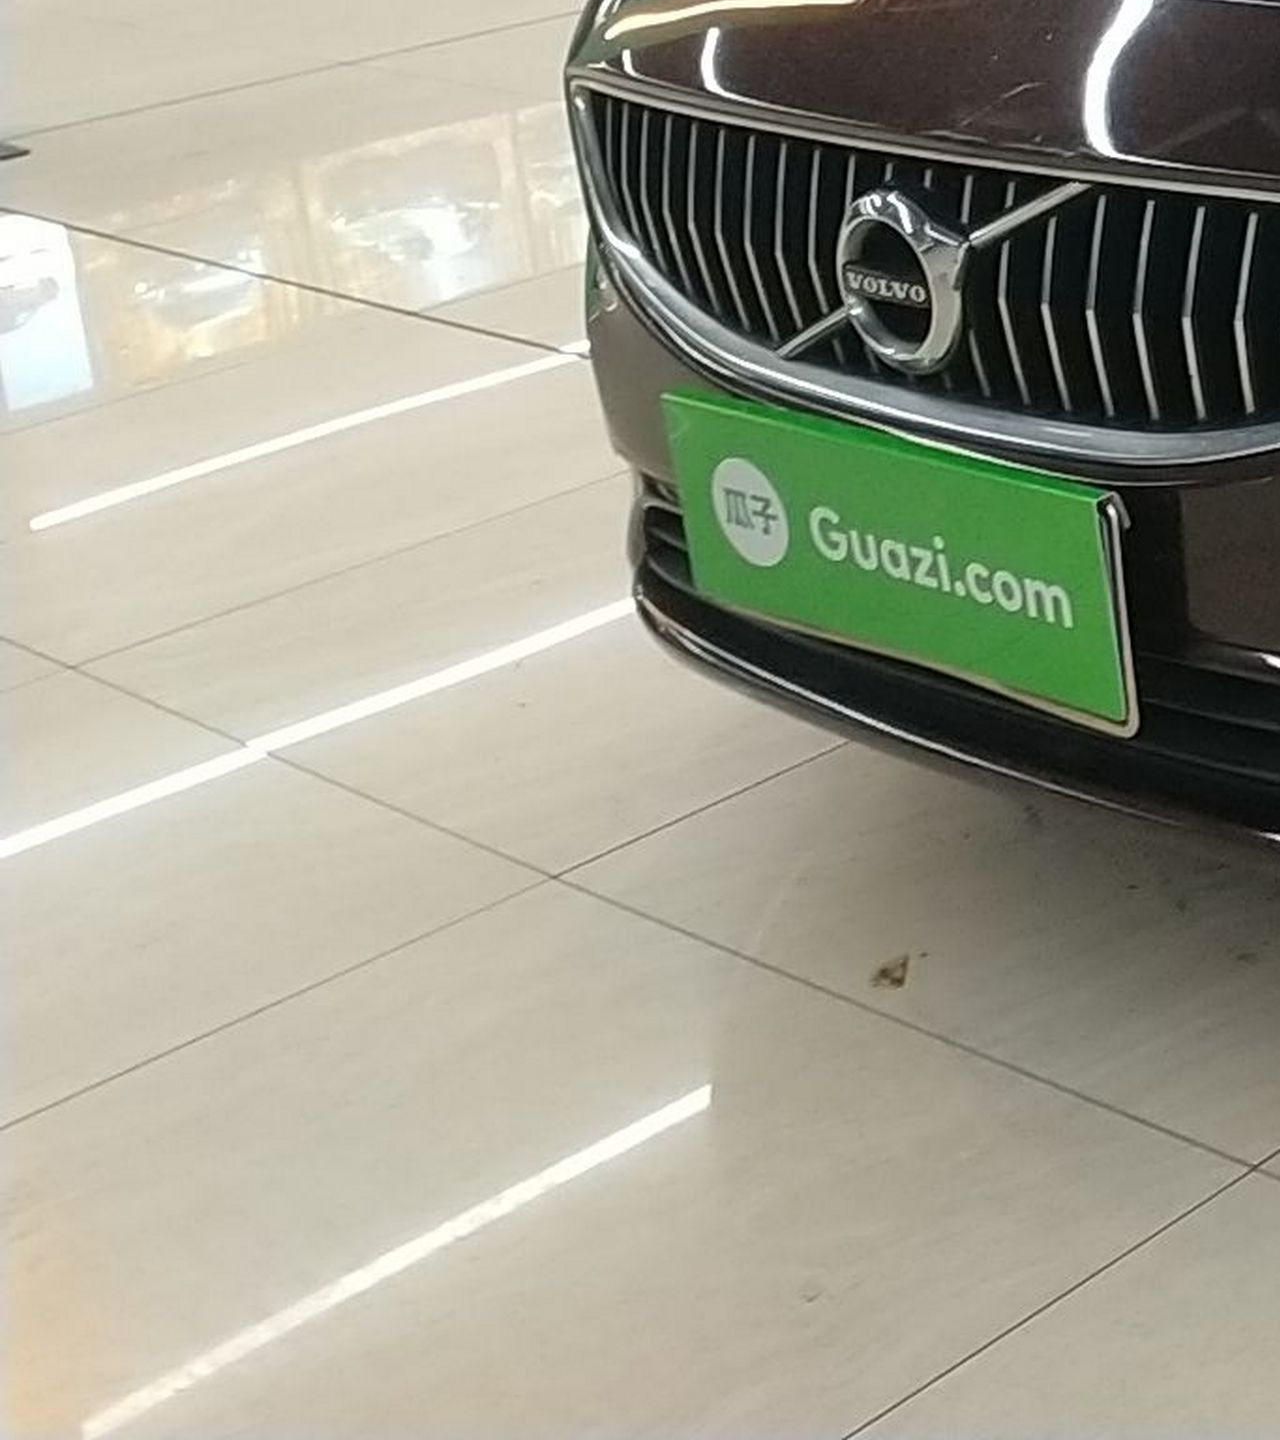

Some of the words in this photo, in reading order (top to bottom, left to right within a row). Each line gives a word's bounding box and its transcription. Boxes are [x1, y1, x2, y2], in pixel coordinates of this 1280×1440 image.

[846, 271, 926, 303] VOLVO
[722, 486, 779, 536] 瓜子
[808, 505, 1074, 629] Guazi.com
